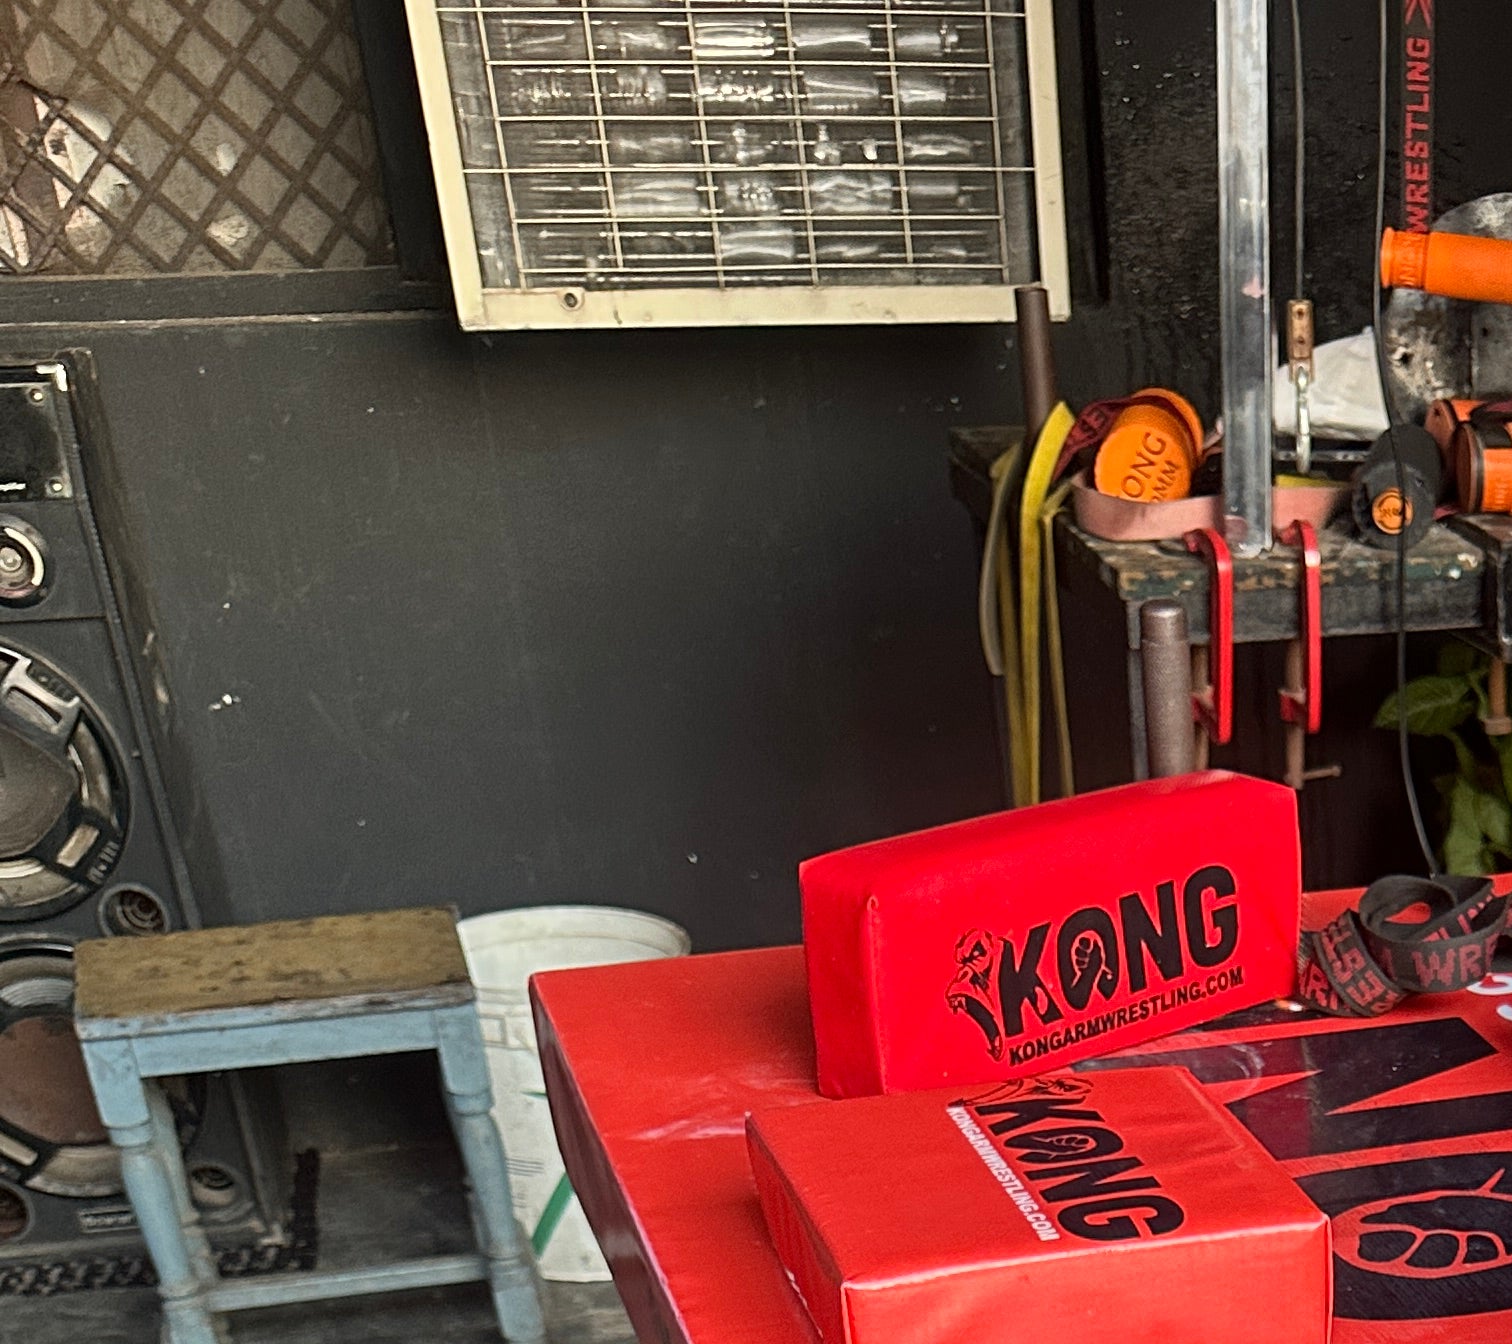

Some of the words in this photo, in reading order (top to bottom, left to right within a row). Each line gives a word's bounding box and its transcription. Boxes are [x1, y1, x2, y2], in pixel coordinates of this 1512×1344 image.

[1405, 36, 1432, 235] WRESTLING
[1120, 431, 1167, 499] ONG
[998, 865, 1239, 1038] KONG
[1008, 966, 1245, 1067] KONGARMWRESTLING.COM
[946, 1105, 1061, 1242] KONGARMWRESTLING.COM
[974, 1095, 1185, 1241] KONG
